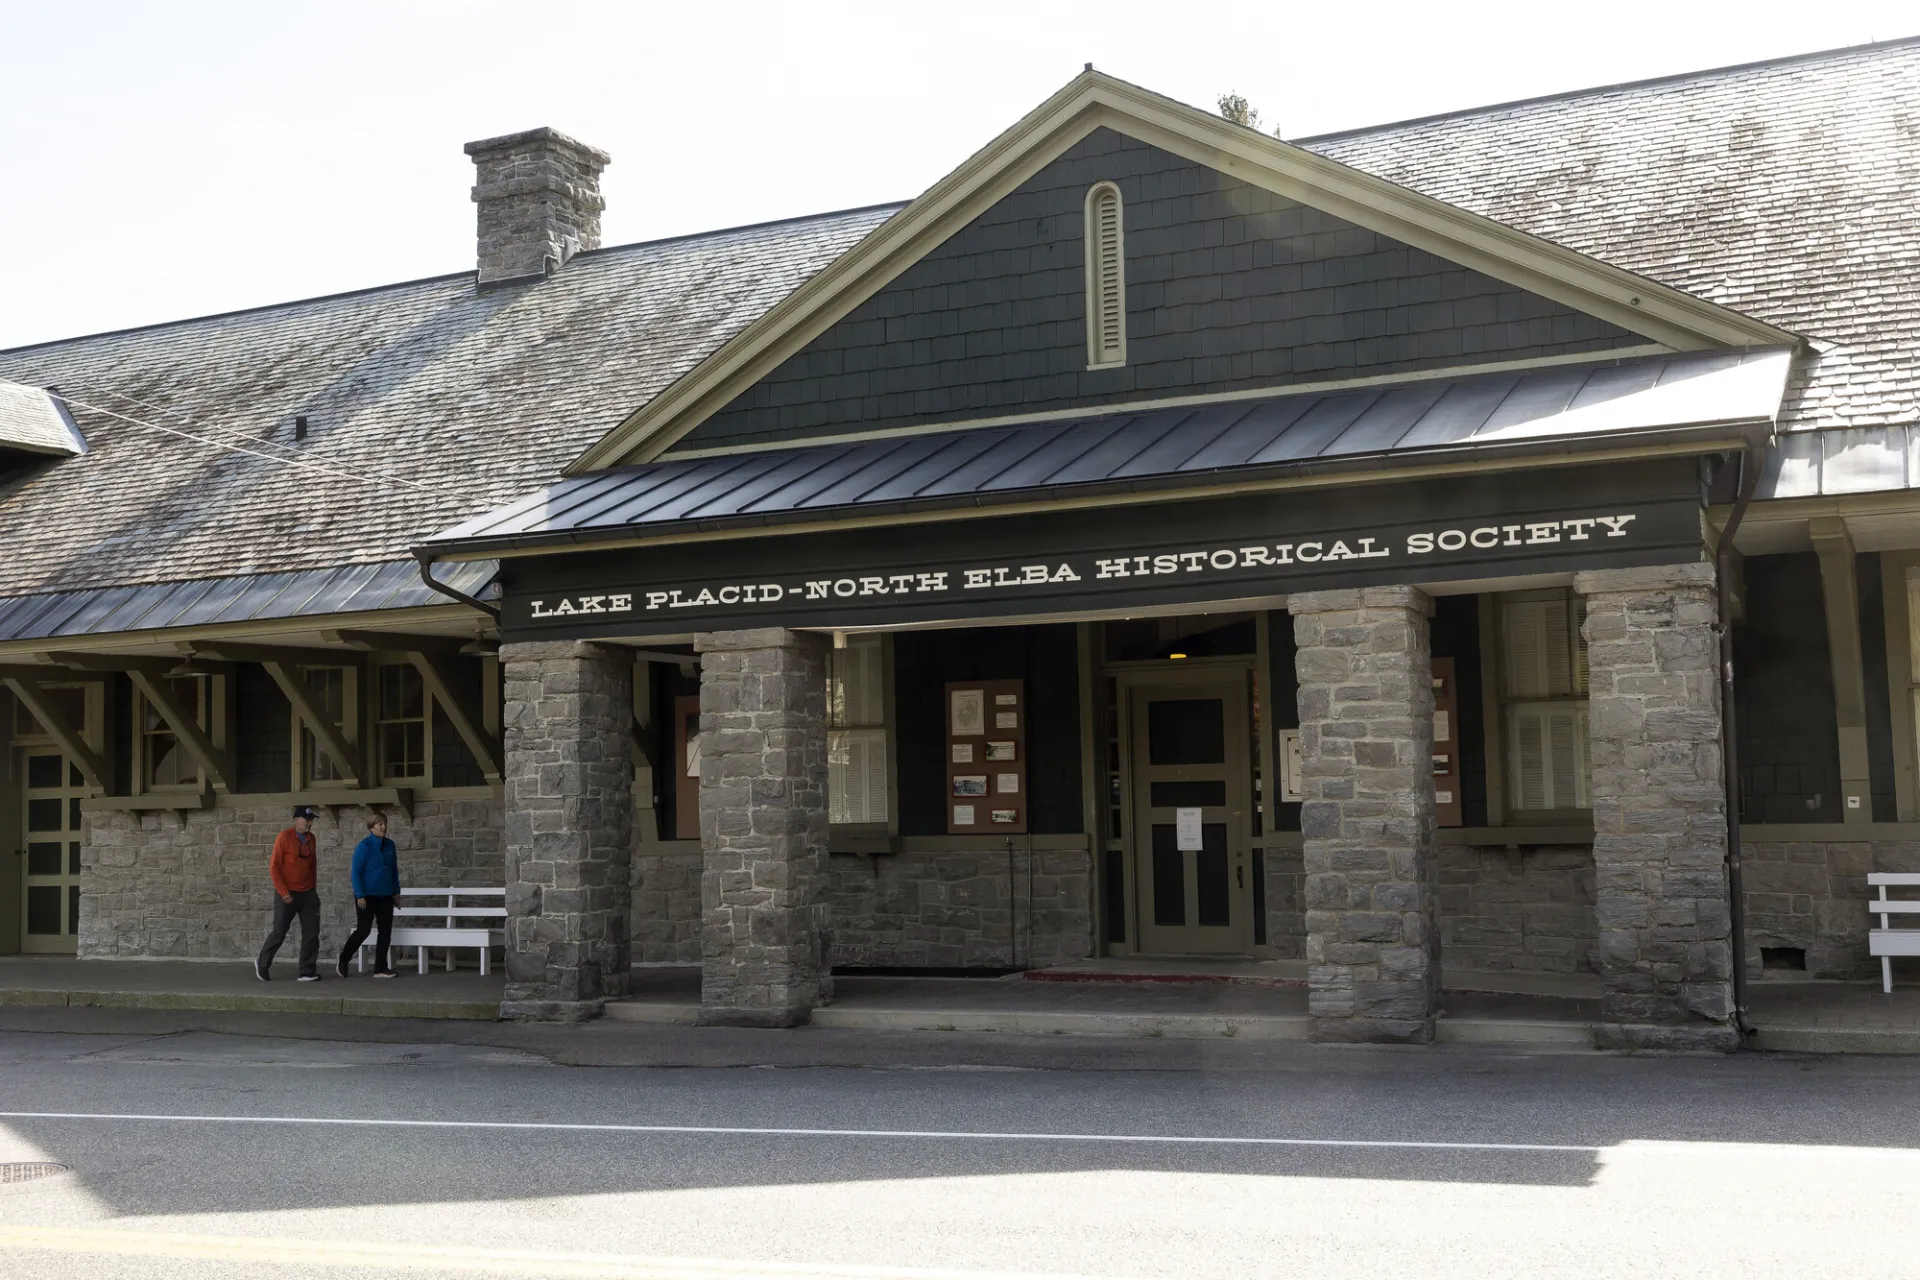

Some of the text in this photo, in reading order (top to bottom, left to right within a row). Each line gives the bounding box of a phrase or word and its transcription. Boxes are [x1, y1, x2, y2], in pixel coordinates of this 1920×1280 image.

[531, 594, 632, 618] LAKE
[963, 564, 1082, 589] ELBA
[1095, 538, 1390, 579] HISTORICAL
[1406, 514, 1637, 555] SOCIETY
